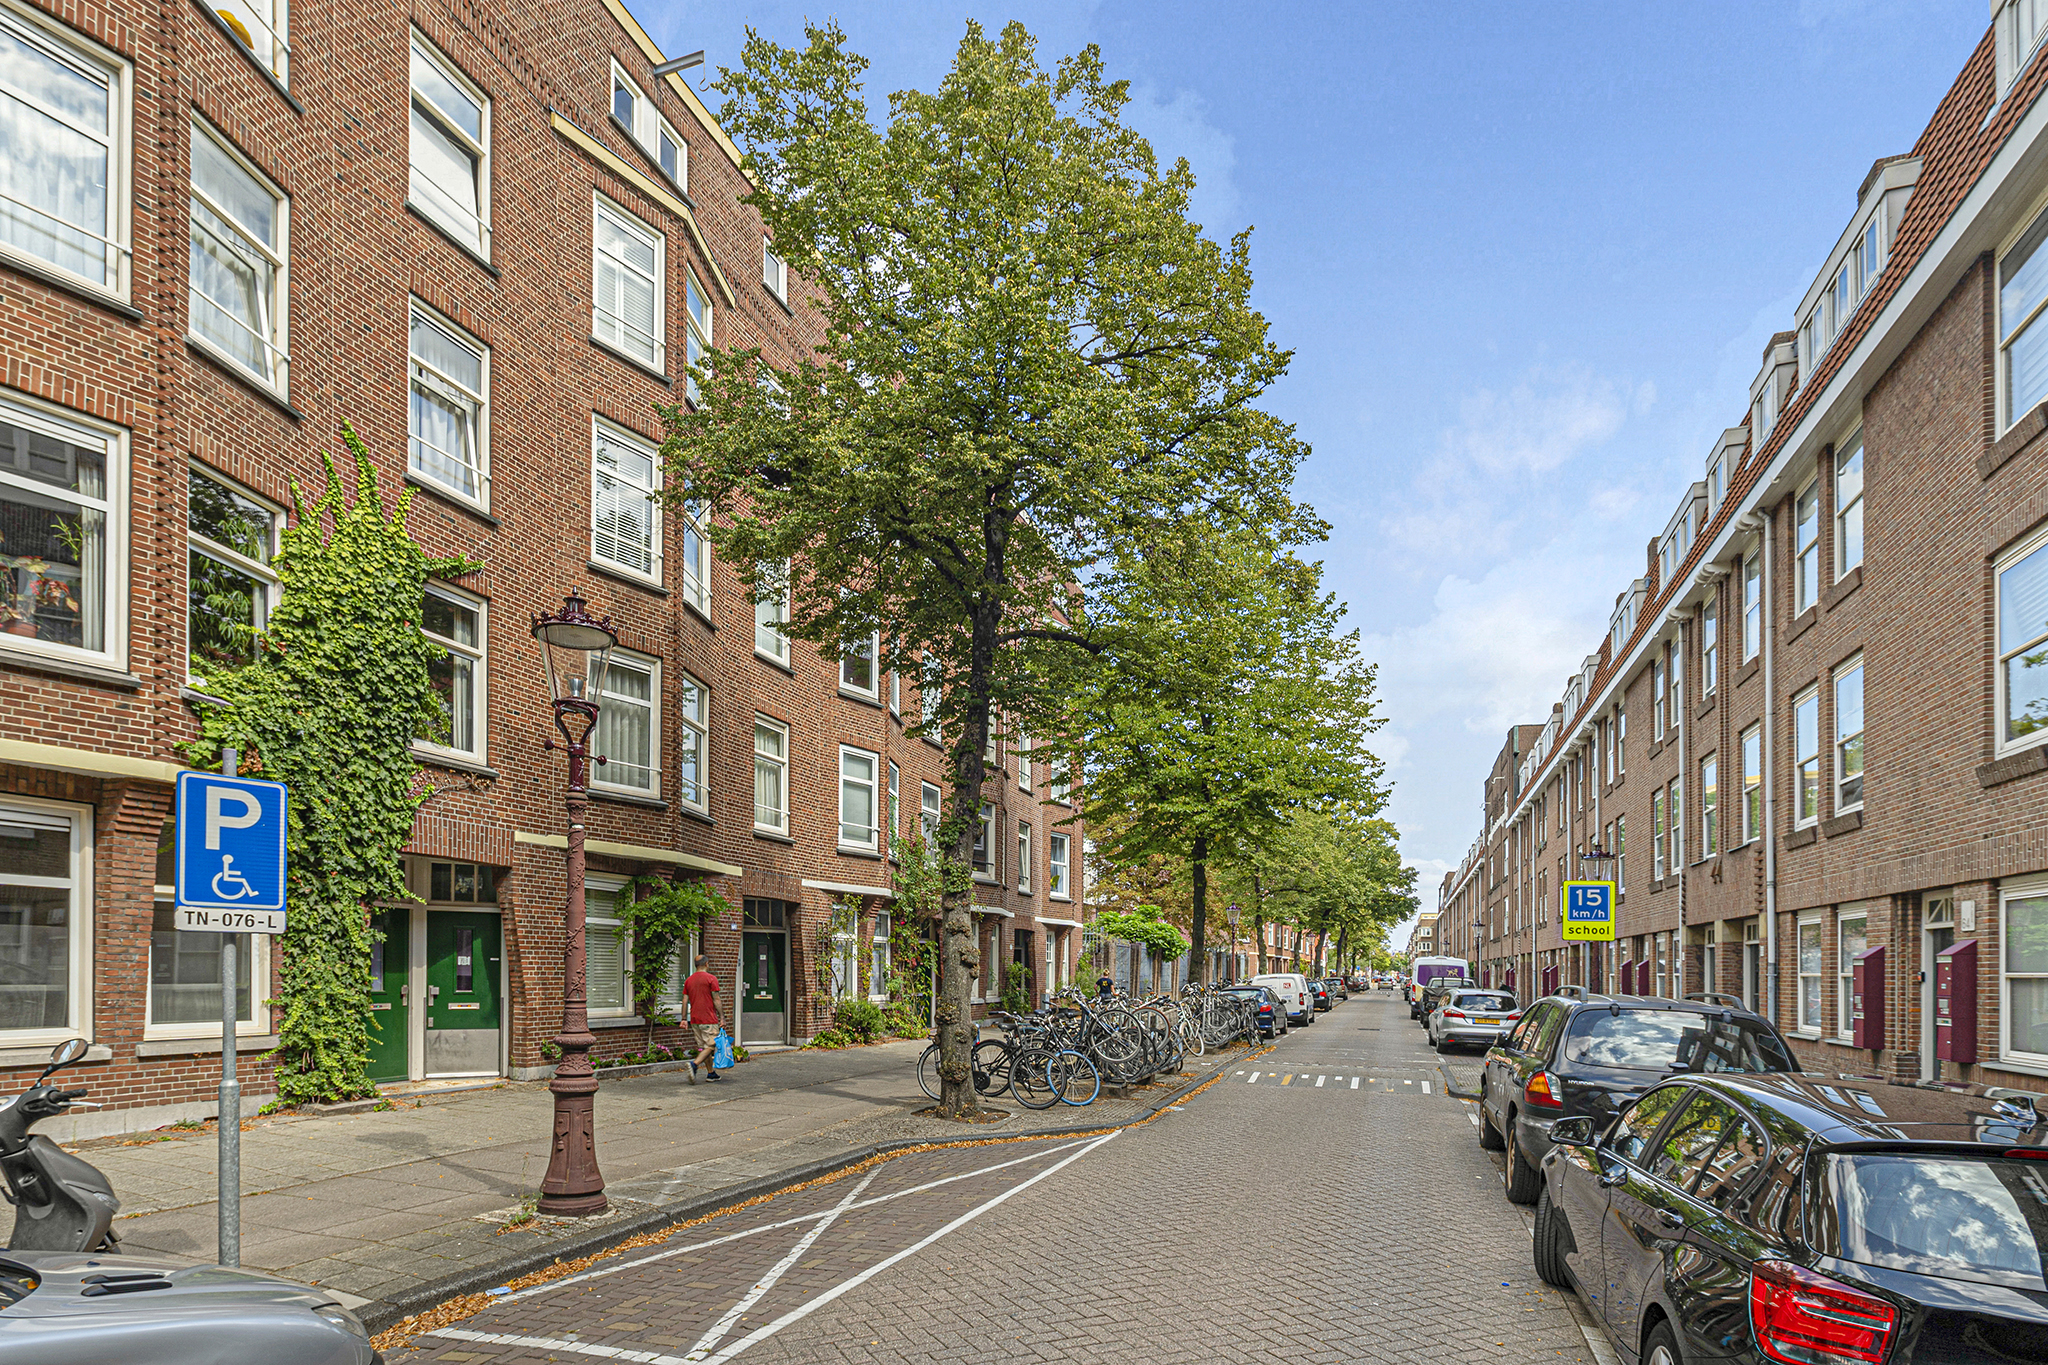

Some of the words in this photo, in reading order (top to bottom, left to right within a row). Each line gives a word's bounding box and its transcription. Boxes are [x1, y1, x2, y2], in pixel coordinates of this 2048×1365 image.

[205, 785, 262, 850] P
[1576, 889, 1602, 906] 15
[184, 911, 277, 928] TN-076-L
[1572, 909, 1605, 919] km/h
[1568, 925, 1610, 935] school
